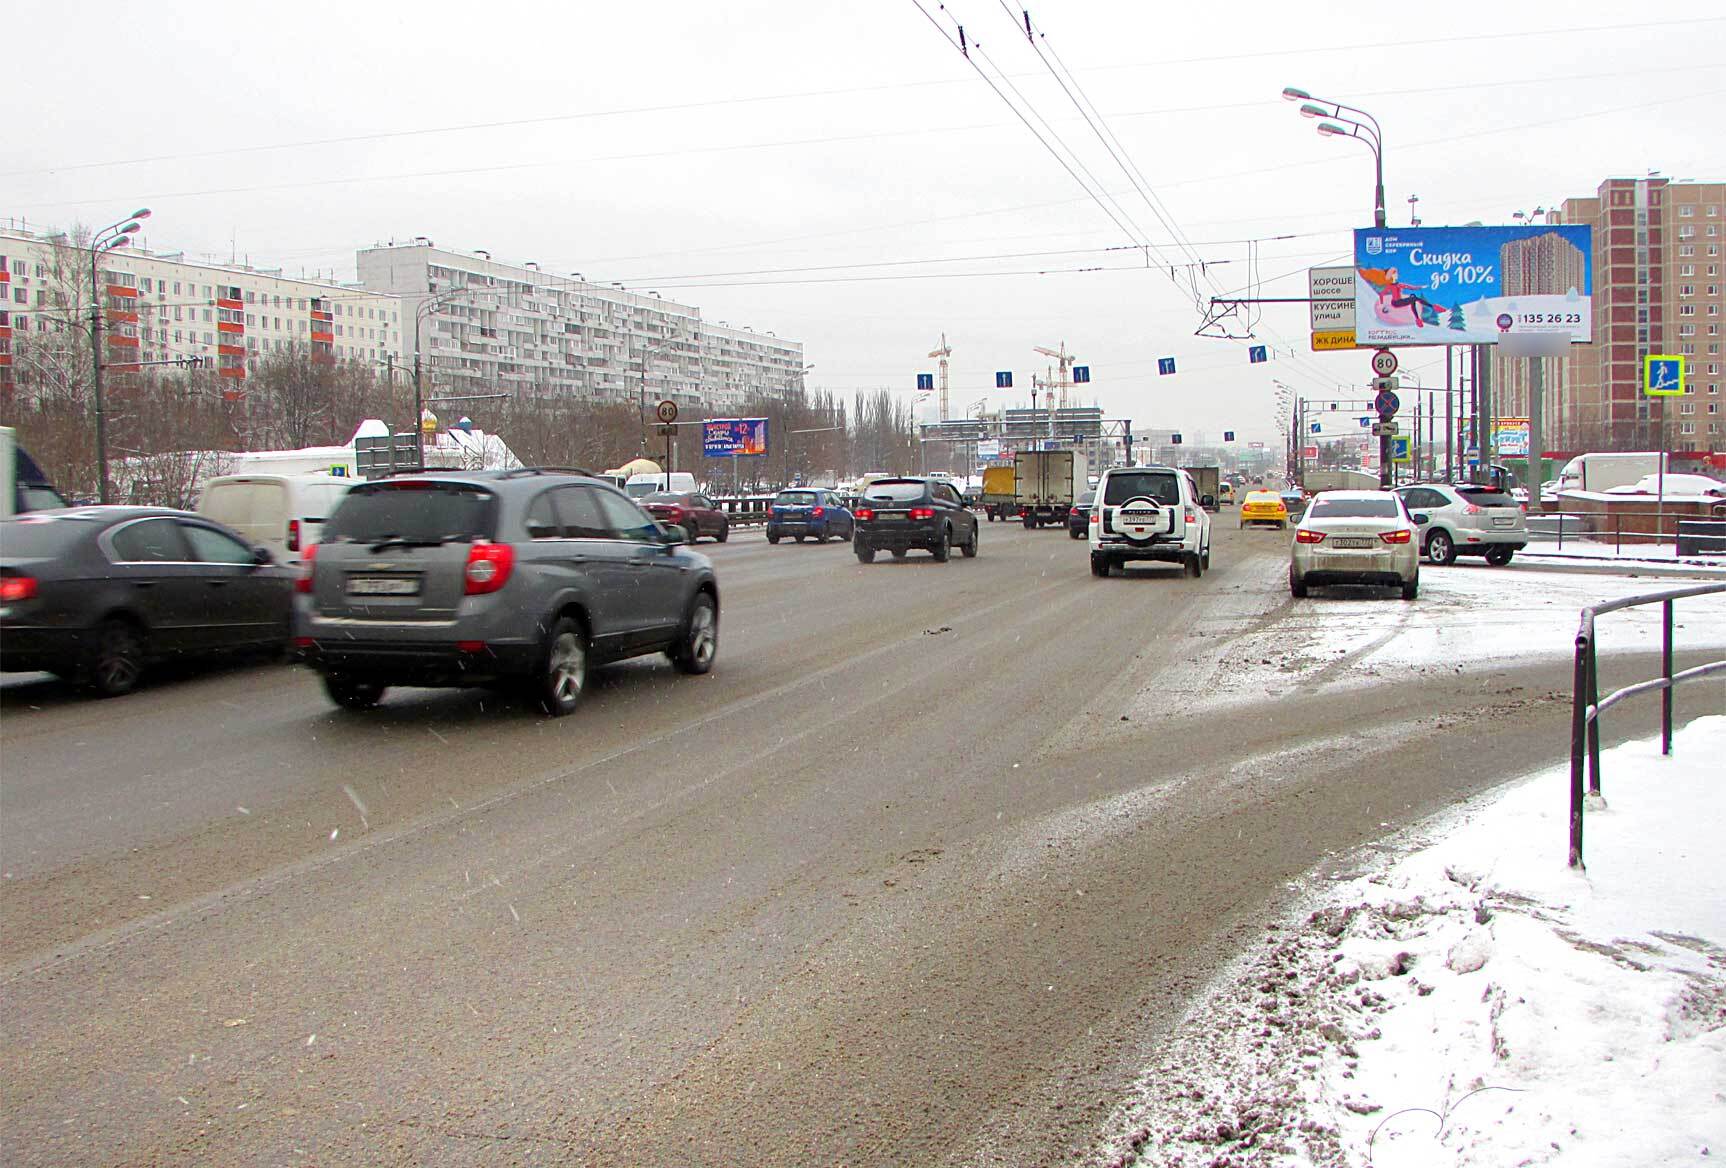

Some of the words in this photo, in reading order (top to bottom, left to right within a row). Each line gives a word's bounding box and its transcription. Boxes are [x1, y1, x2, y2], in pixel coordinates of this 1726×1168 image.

[1409, 248, 1472, 271] Скидка
[1431, 272, 1449, 290] до
[1454, 265, 1494, 284] 10%
[1314, 312, 1341, 321] улица
[1524, 314, 1543, 323] 135
[1547, 314, 1562, 323] 26
[1566, 314, 1580, 323] 23
[1315, 336, 1329, 345] ЖК
[1377, 358, 1393, 369] 80
[662, 407, 674, 416] 80
